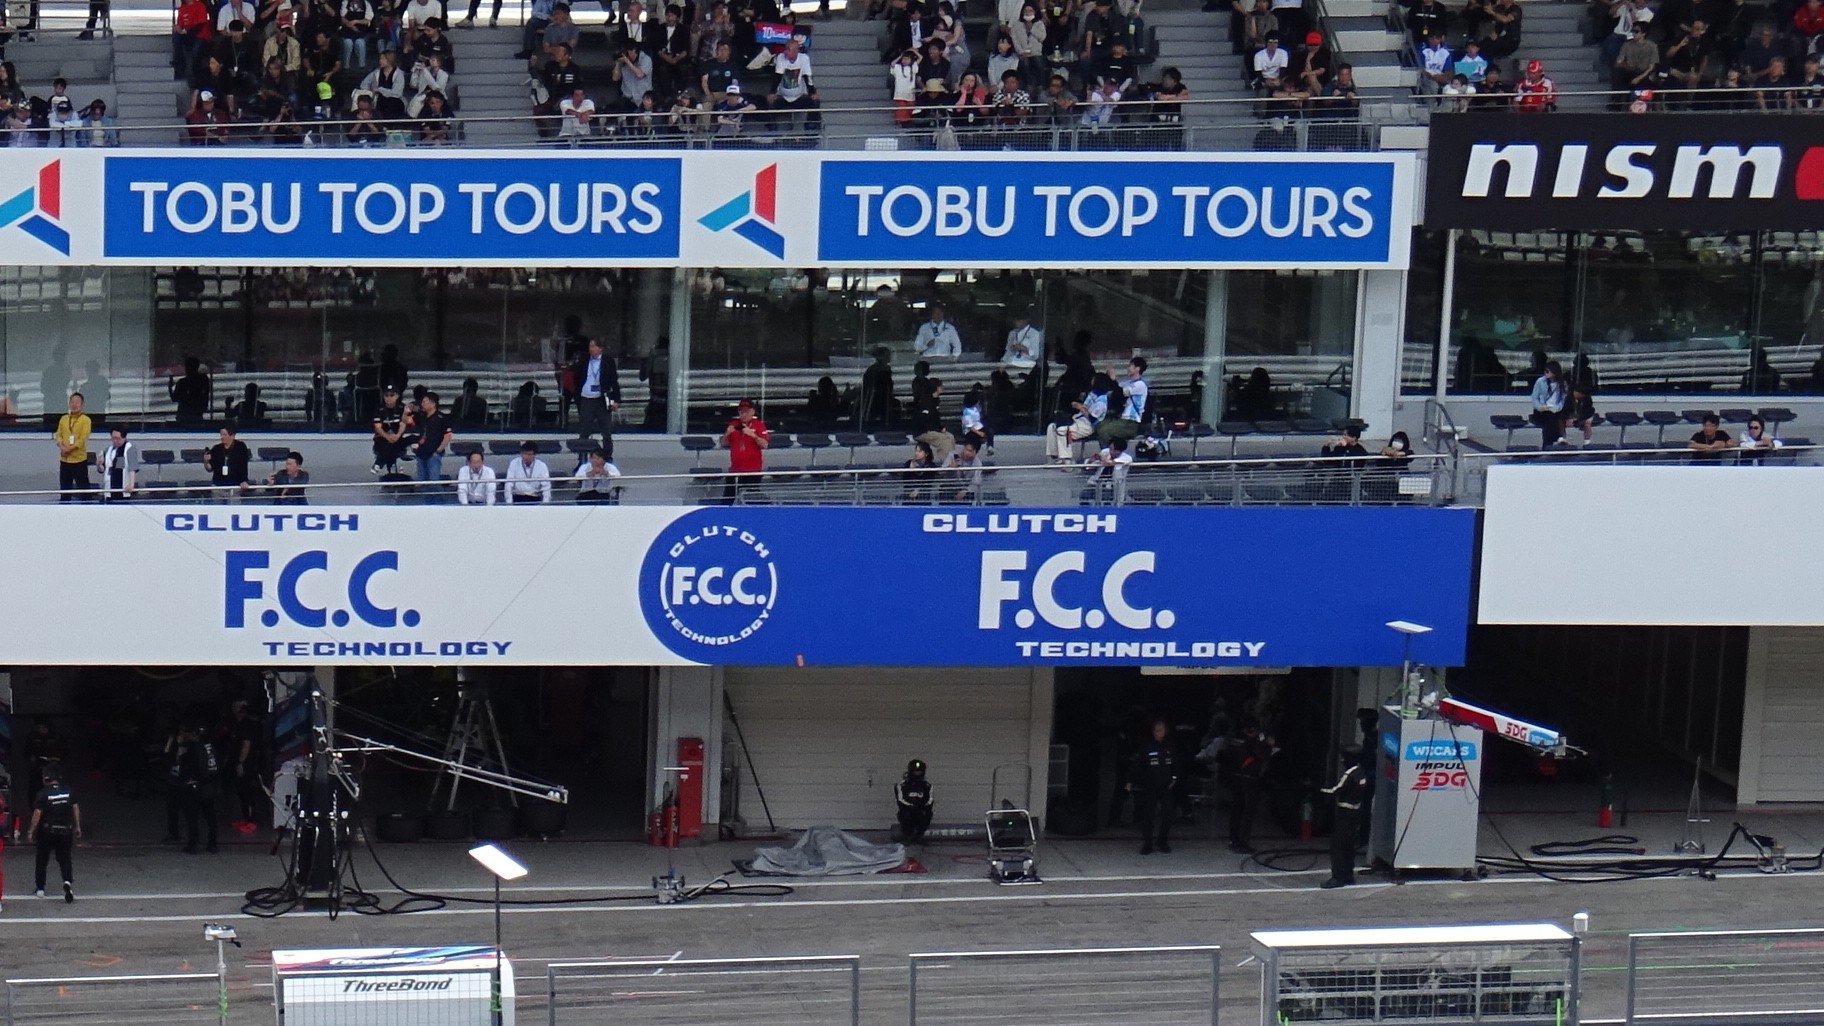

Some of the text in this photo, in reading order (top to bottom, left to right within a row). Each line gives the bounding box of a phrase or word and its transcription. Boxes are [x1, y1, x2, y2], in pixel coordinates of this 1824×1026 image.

[129, 182, 663, 234] TOBU TOP TOURS
[846, 186, 1373, 238] TOBU TOP TOURS
[165, 513, 359, 532] CLUTCH
[923, 514, 1117, 533] CLUTCH
[669, 526, 770, 558] CLUTCH
[224, 550, 421, 629] F.C.C.
[672, 567, 767, 605] F.C.C.
[978, 550, 1175, 630] F.C.C.
[665, 609, 770, 645] TECHNOLOGY
[263, 641, 513, 657] TECHNOLOGY
[1015, 641, 1265, 658] TECHNOLOGY
[343, 978, 453, 993] ThreeBond
